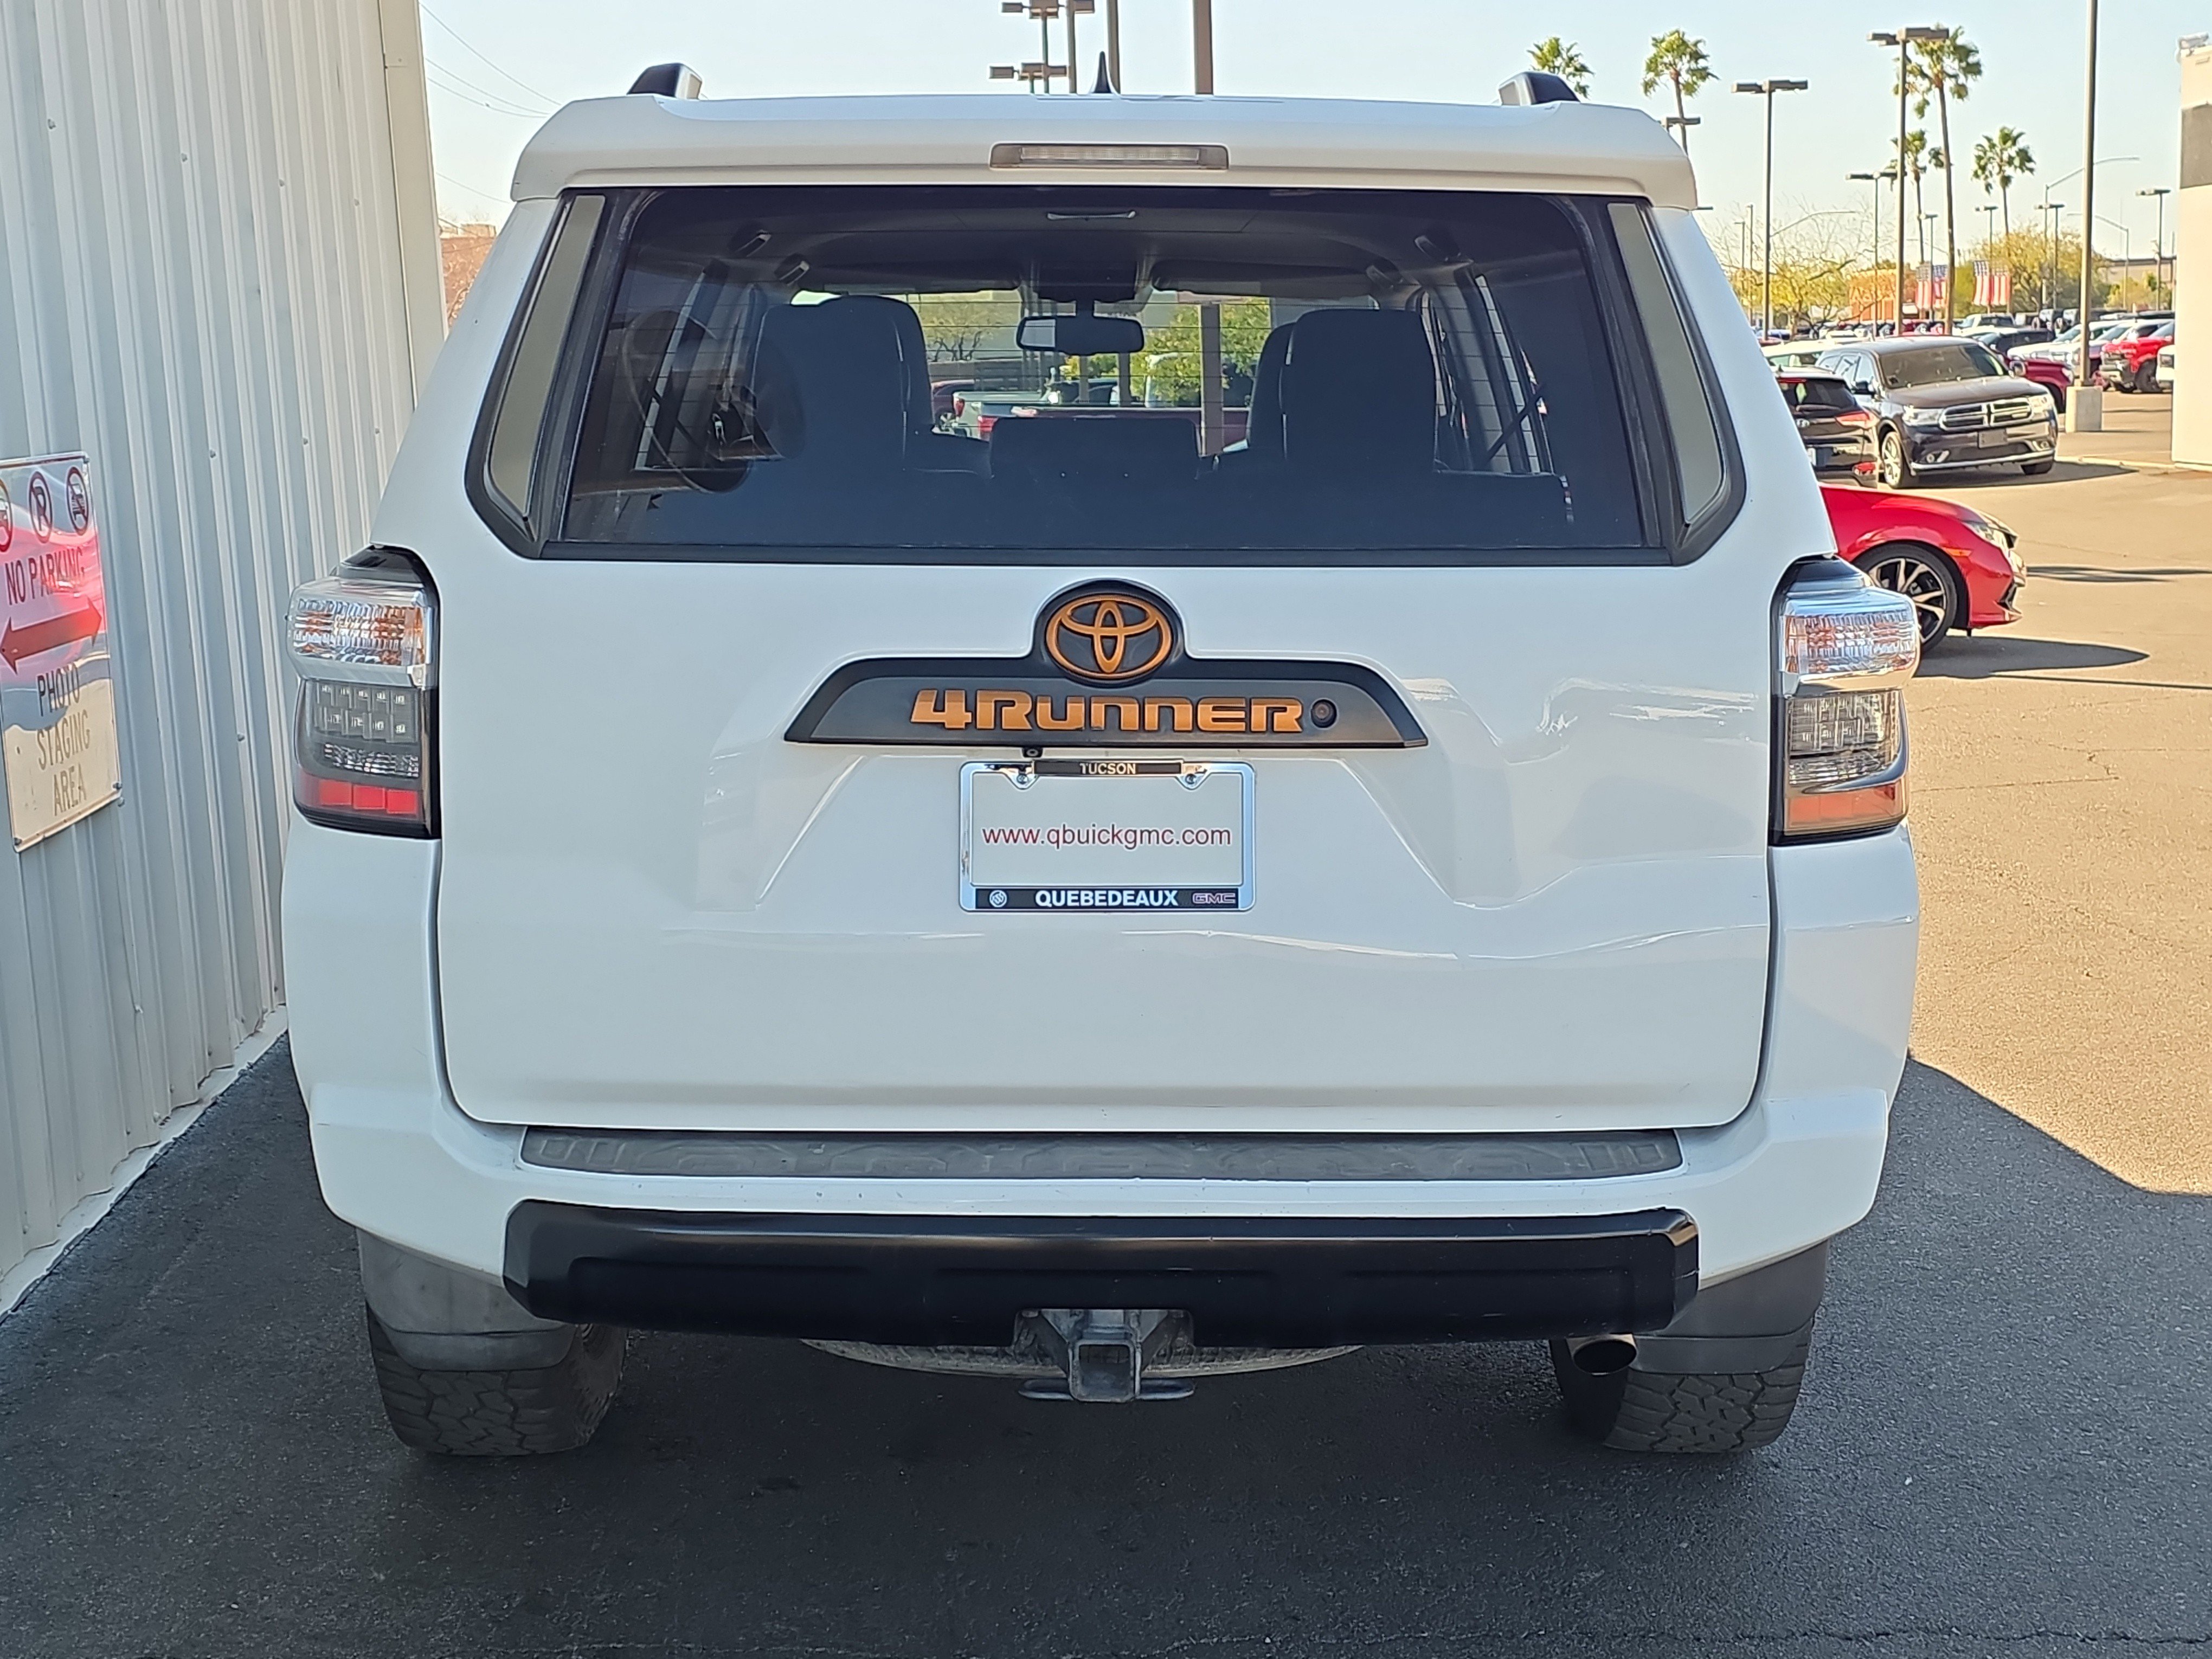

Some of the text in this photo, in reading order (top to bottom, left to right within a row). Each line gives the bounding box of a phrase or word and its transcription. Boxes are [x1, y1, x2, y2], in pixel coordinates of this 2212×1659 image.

[5, 546, 85, 606] NO PARKING
[37, 663, 80, 717] PHOTO
[37, 709, 91, 771] STAGING
[54, 762, 87, 817] AREA
[1079, 762, 1136, 775] TUCSON
[982, 823, 1232, 850] www.qbuickgmc.com
[1034, 890, 1237, 907] QUEBEDEAUX GMC
